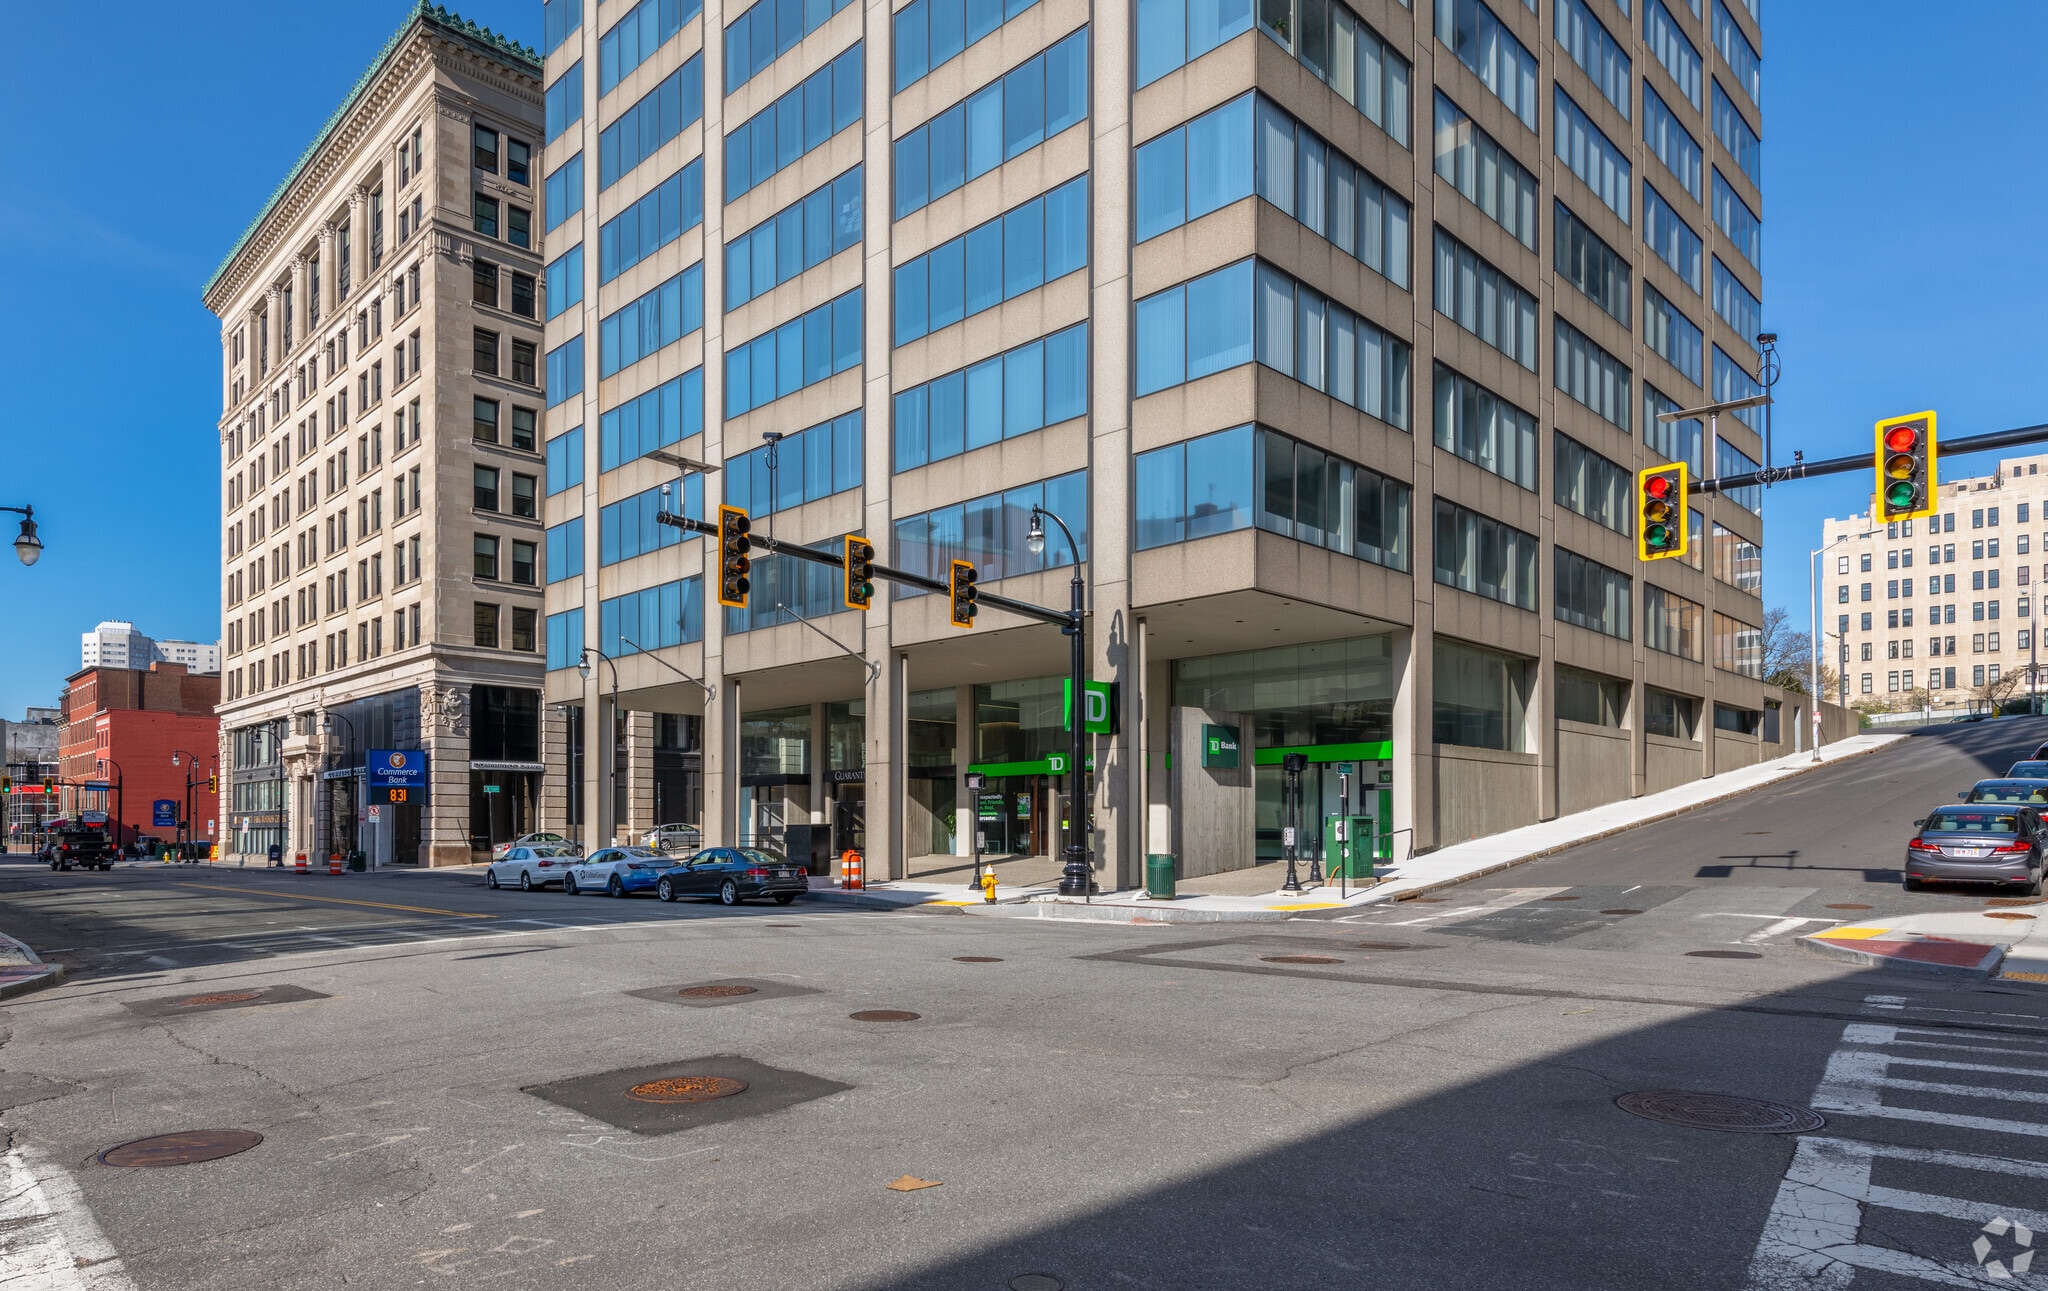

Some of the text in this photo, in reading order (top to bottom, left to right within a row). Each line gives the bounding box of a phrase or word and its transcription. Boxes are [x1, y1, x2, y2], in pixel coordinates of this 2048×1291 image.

[1210, 740, 1237, 751] TD Bank
[1048, 757, 1064, 771] TD
[377, 767, 418, 776] Commerce
[834, 771, 865, 780] GUARANT
[388, 775, 407, 784] Bank
